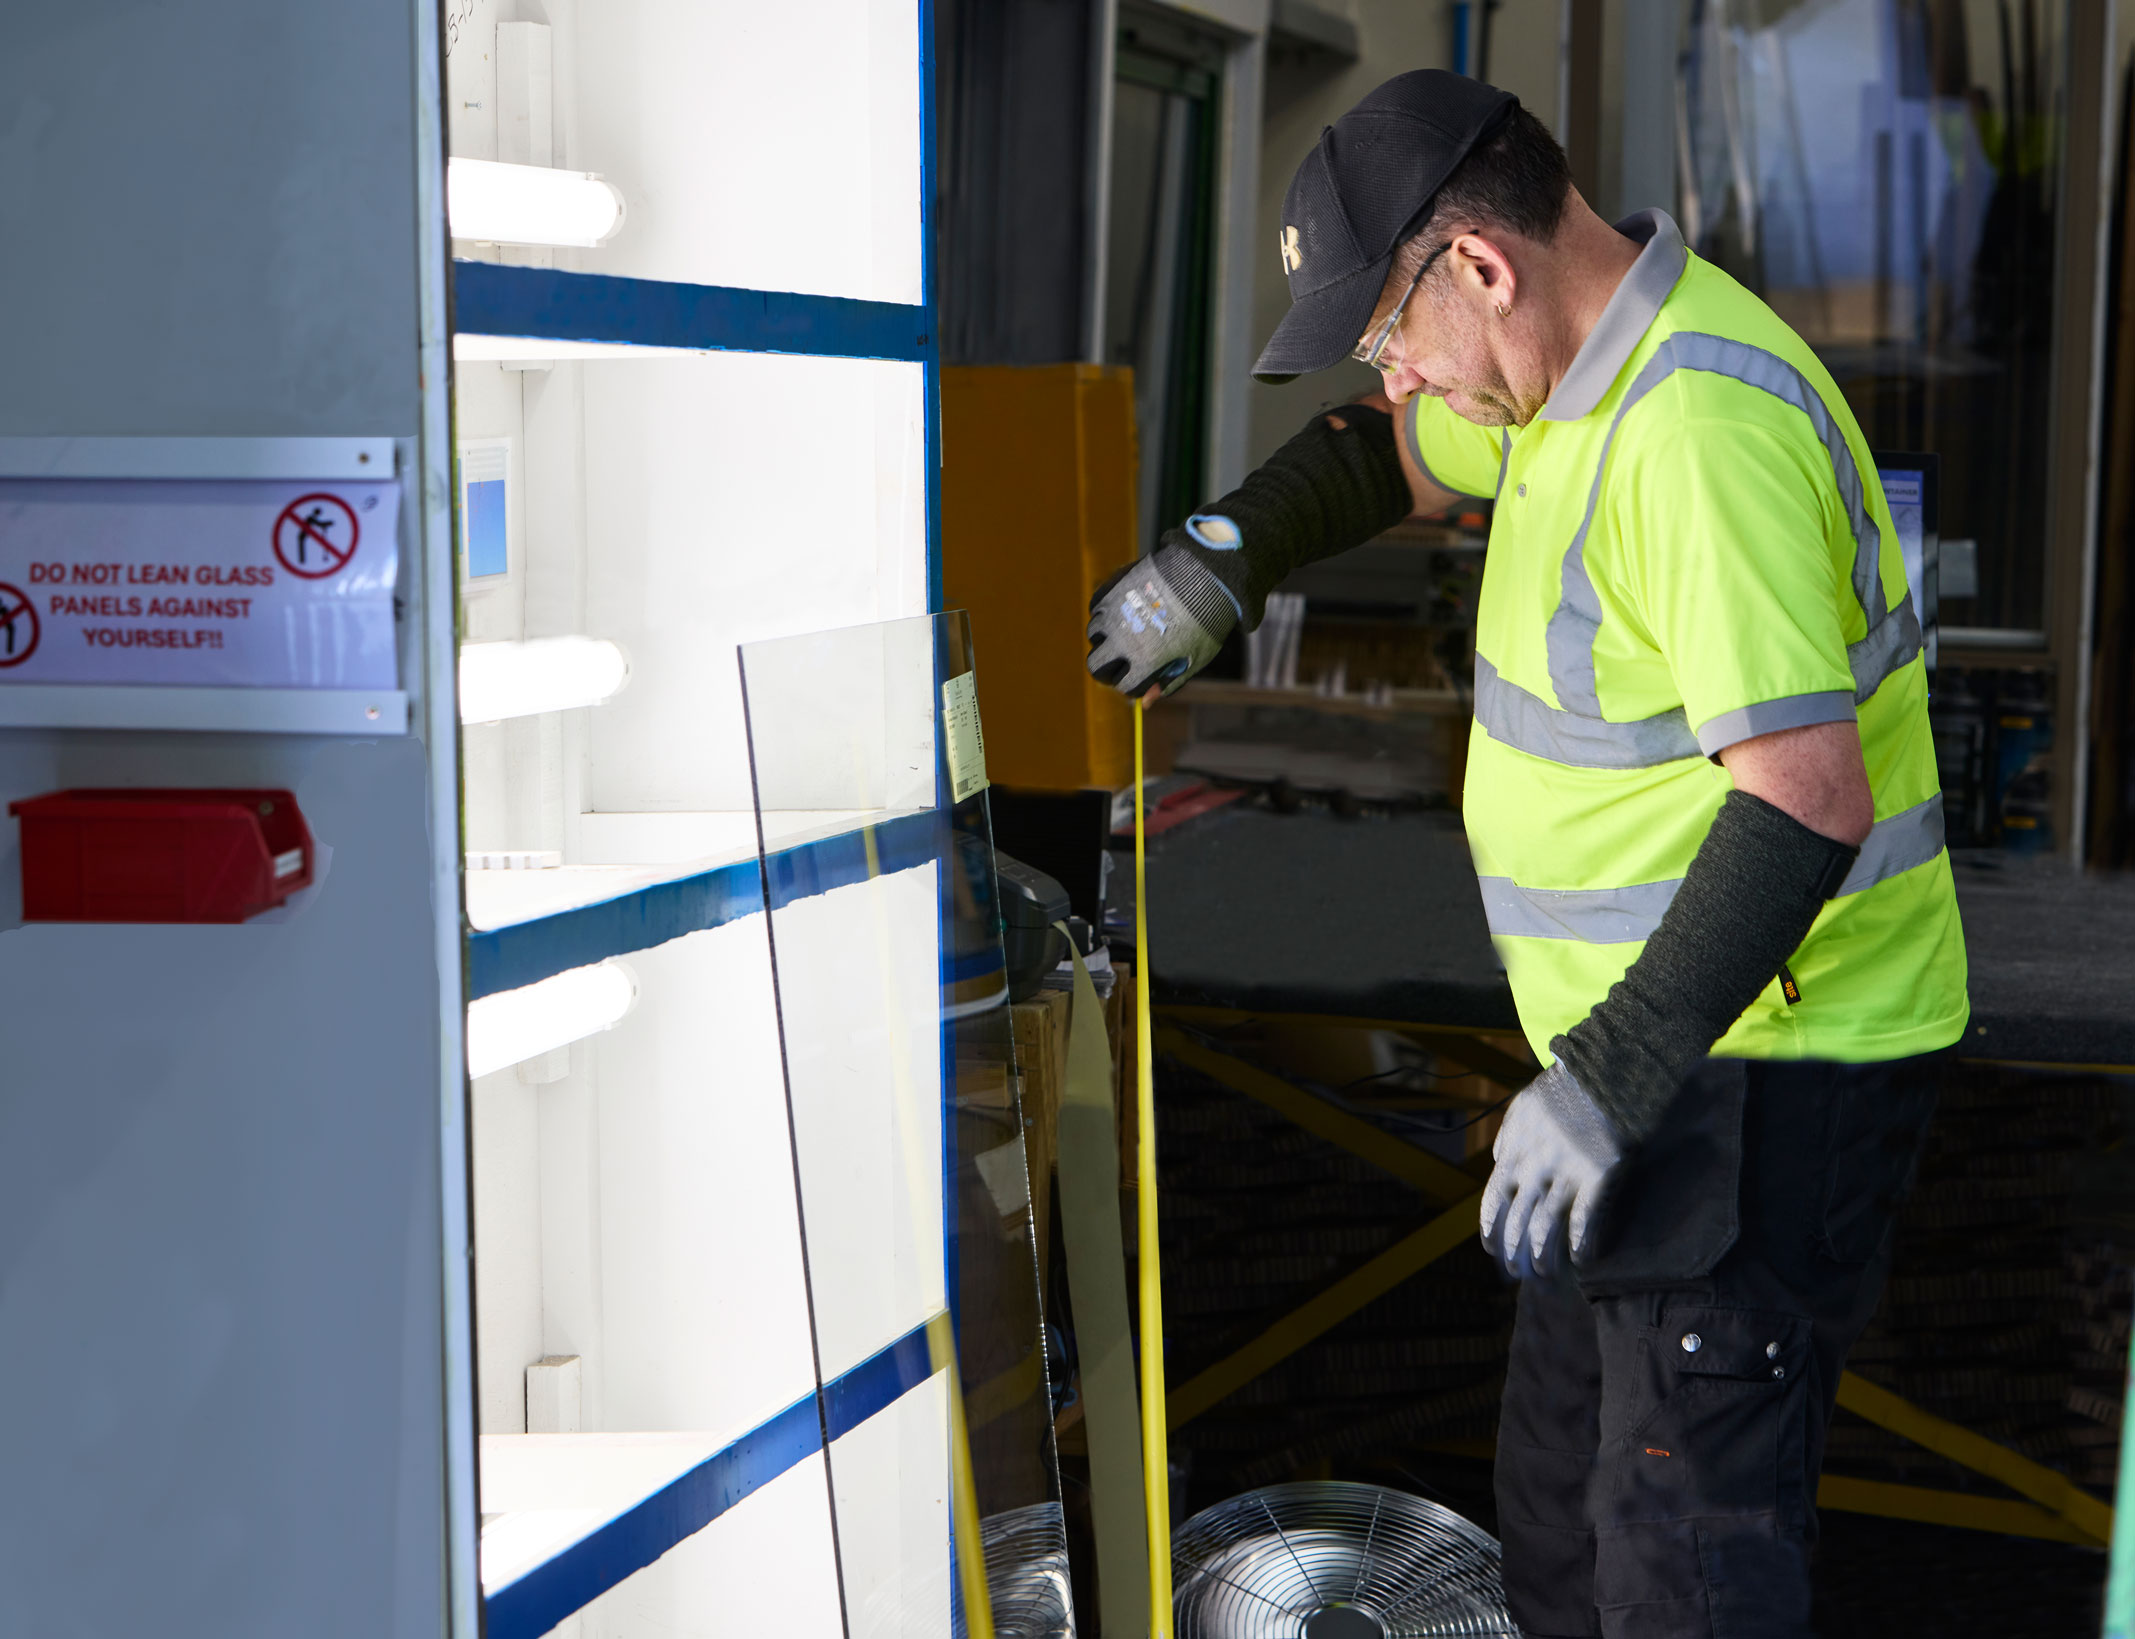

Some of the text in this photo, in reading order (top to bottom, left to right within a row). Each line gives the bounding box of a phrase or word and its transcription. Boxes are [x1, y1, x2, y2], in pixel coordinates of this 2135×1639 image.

[29, 562, 275, 587] DO NOT LEAN GLASS
[50, 595, 252, 618] PANELS AGAINST
[82, 627, 224, 649] YOURSELF!!
[1785, 981, 1796, 998] site
